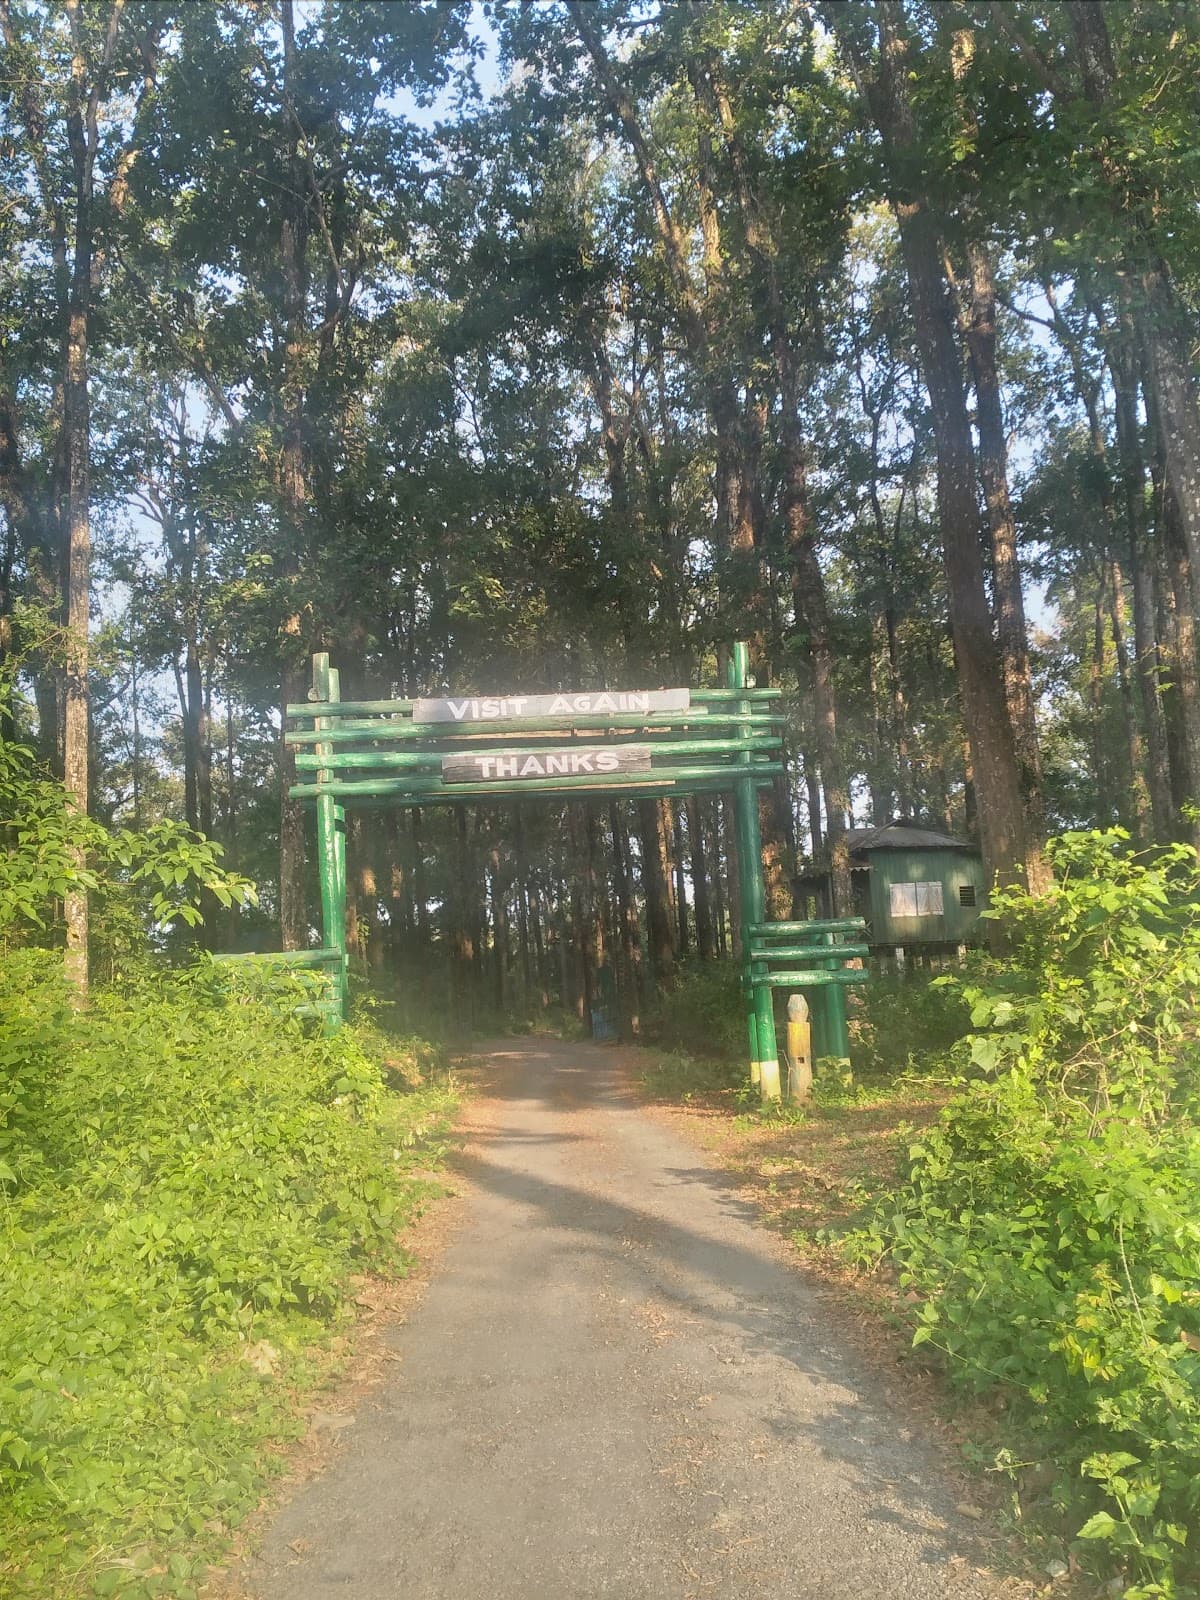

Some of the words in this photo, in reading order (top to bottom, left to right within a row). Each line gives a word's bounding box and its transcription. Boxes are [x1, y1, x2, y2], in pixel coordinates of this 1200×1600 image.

[447, 698, 528, 720] VISIT
[550, 693, 650, 715] AGAIN
[475, 752, 620, 778] THANKS
